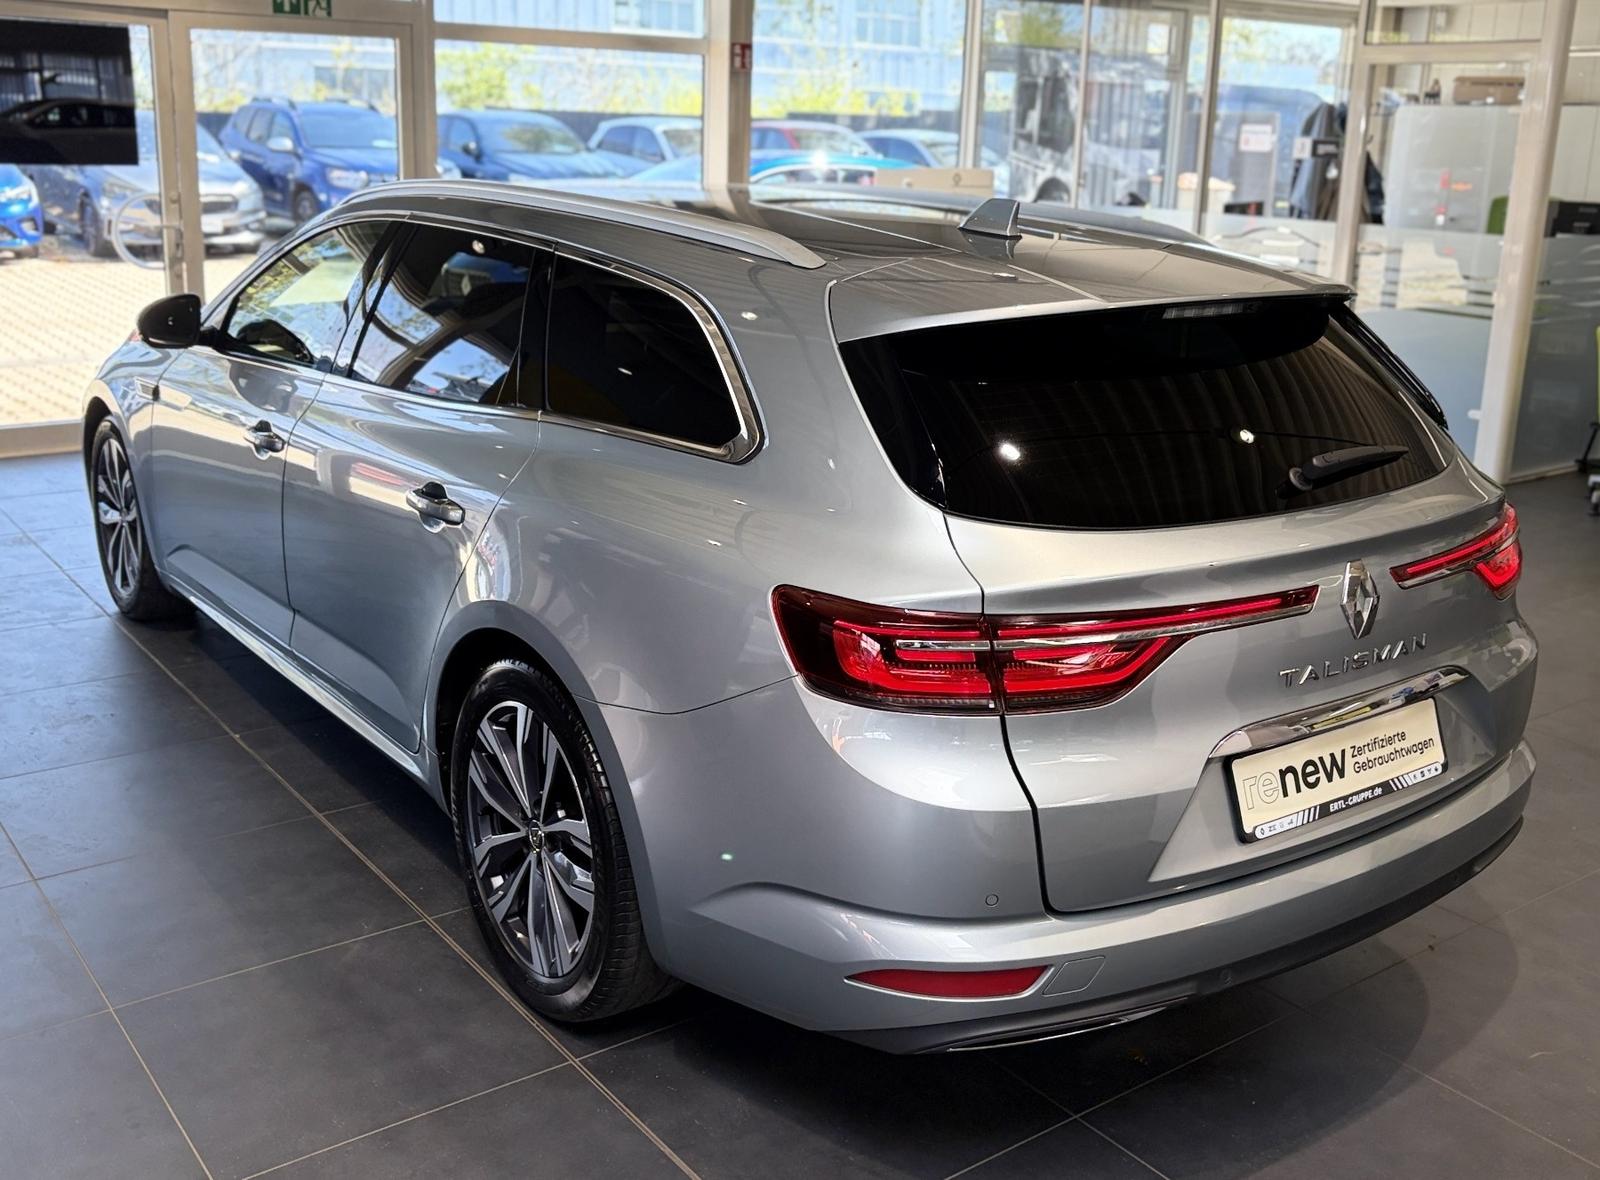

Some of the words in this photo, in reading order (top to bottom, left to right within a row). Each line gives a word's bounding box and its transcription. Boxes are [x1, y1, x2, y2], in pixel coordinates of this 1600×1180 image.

[1279, 632, 1427, 688] TALISMAN
[1350, 731, 1407, 758] Zertifizierte
[1353, 737, 1435, 774] Gebrauchtwagen
[1242, 748, 1346, 811] renew
[1329, 786, 1383, 812] ERTL-GRUPPE.de
